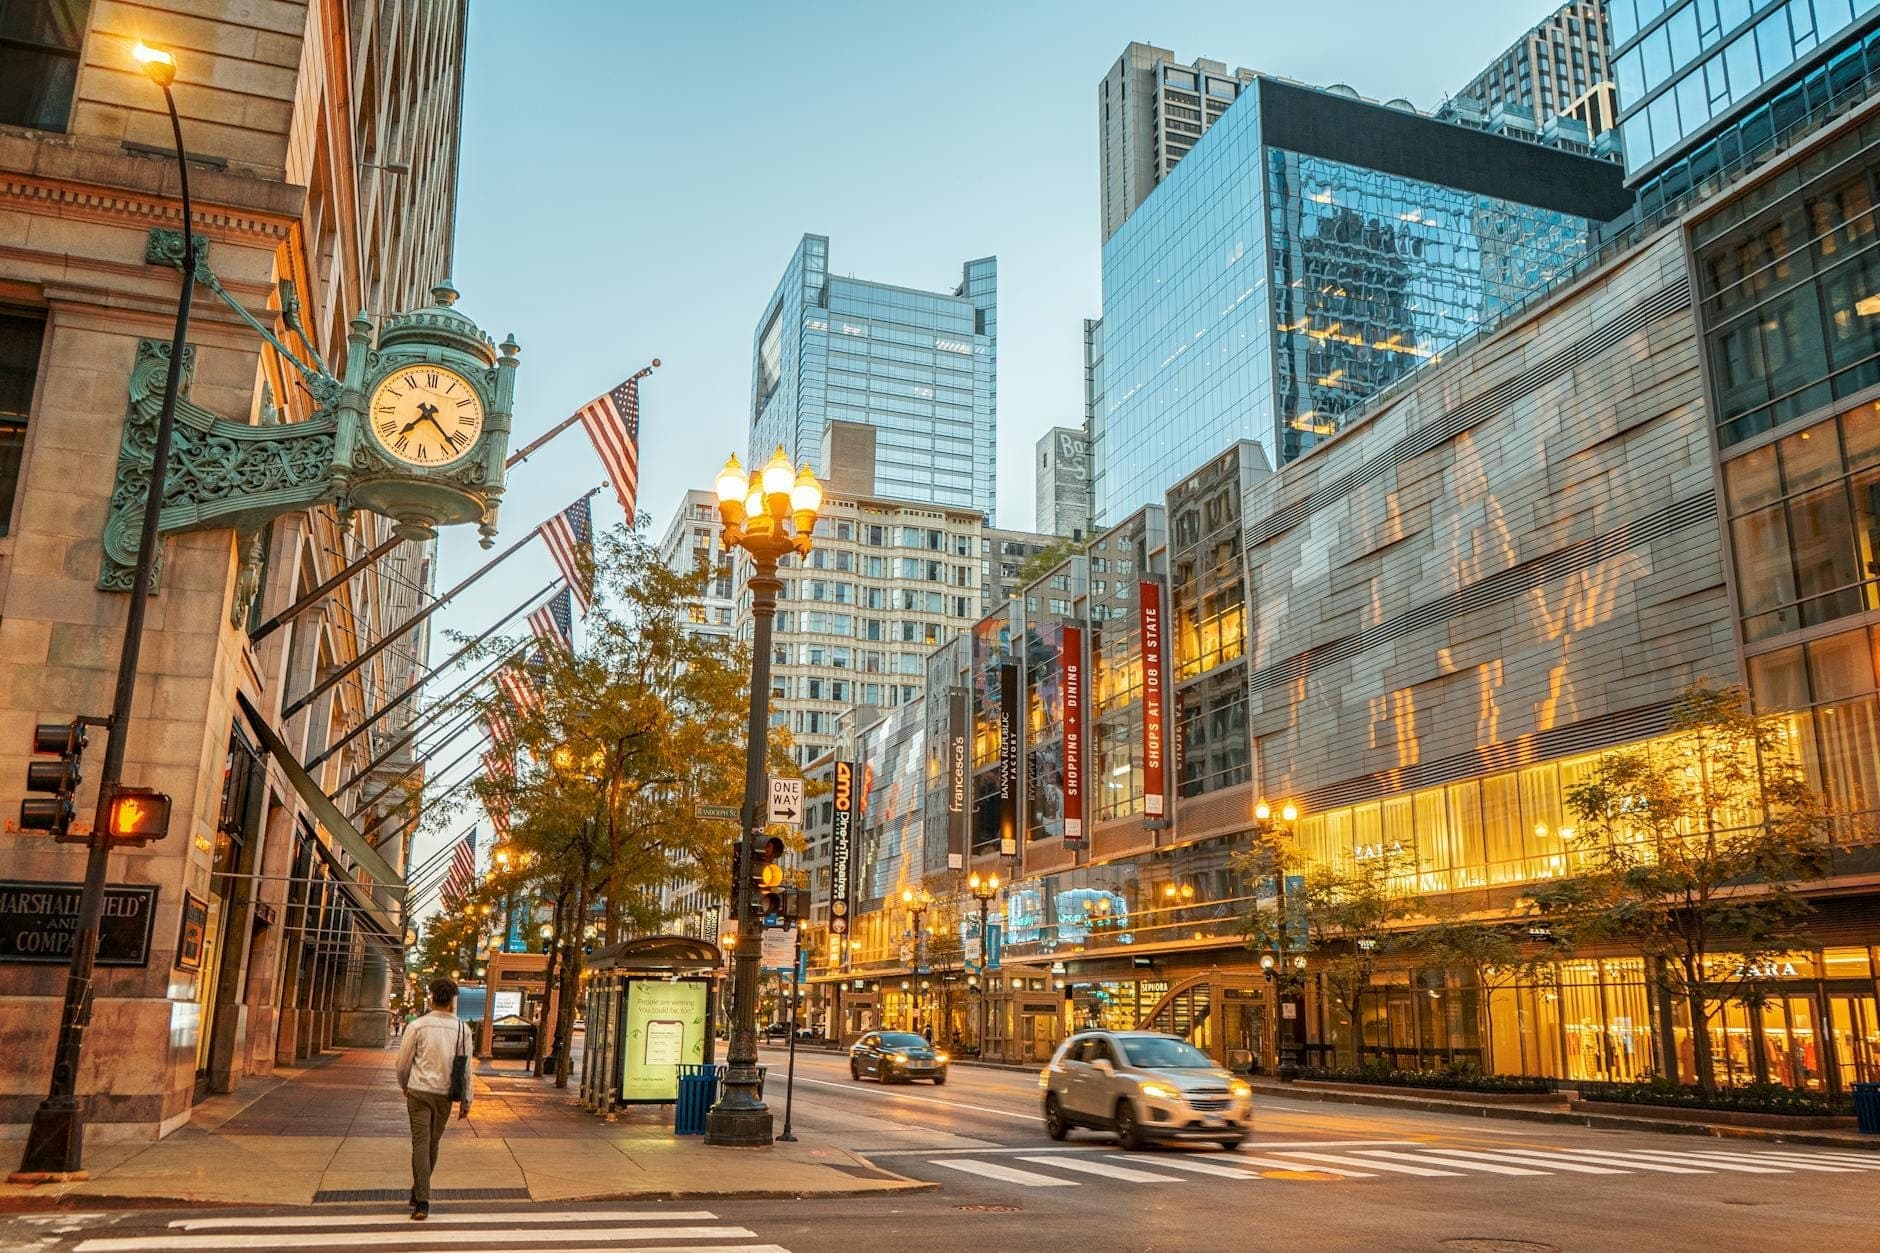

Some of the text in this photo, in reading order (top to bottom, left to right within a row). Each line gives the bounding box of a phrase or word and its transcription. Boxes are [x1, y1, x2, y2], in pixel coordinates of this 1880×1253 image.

[403, 375, 418, 391] XI
[425, 373, 439, 389] XII
[445, 382, 457, 394] I
[455, 399, 472, 408] II
[458, 416, 475, 426] III
[394, 435, 409, 453] VII
[1067, 665, 1078, 707] DINING
[1146, 607, 1159, 769] SHOPS AT 108 N STATE
[1001, 711, 1010, 799] BANANA REPUBLIC
[1068, 733, 1078, 796] SHOPPING
[949, 736, 964, 813] francesca's
[774, 782, 799, 793] ONE
[773, 794, 799, 806] WAY
[101, 896, 140, 917] IELD
[16, 931, 106, 953] COMPAY
[1735, 962, 1799, 977] ZARA
[1142, 981, 1169, 992] SEPHORA
